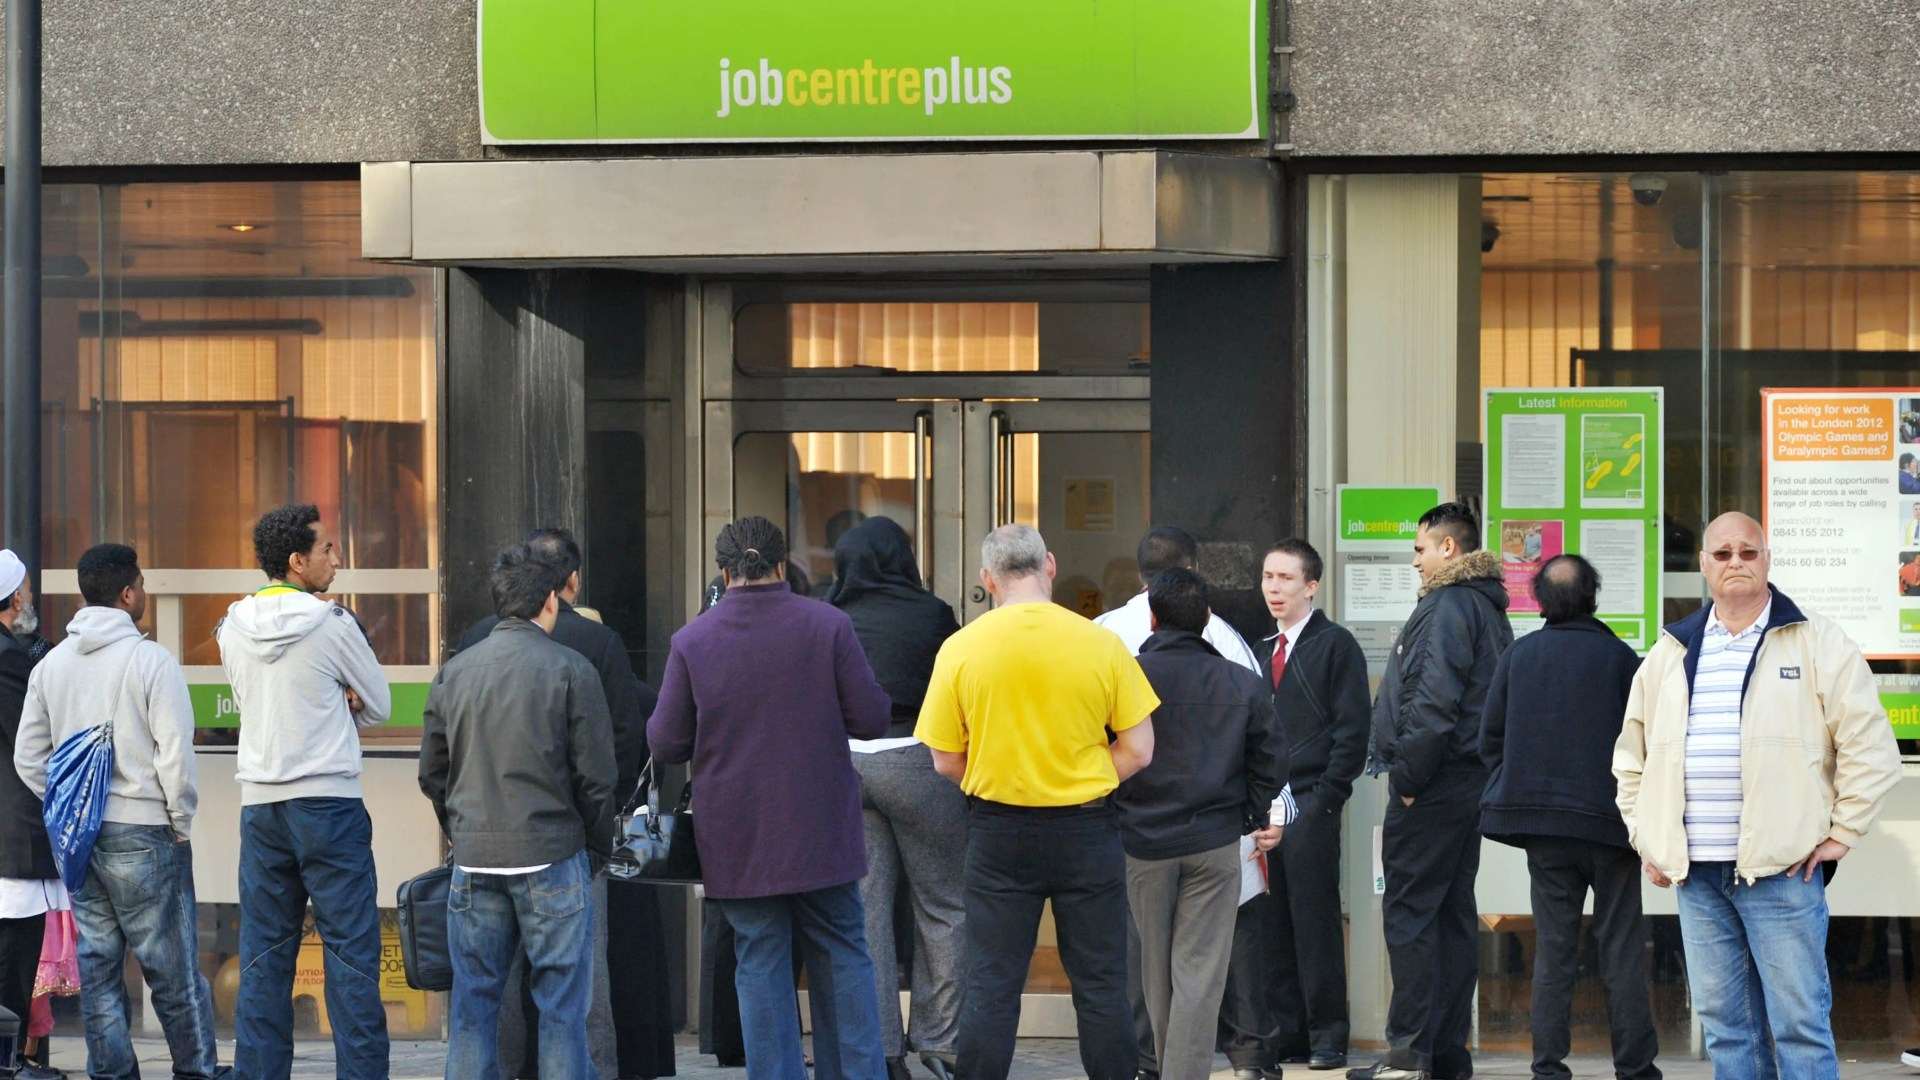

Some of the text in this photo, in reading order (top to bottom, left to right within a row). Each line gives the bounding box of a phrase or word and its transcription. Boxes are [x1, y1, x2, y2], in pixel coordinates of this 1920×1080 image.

[716, 56, 1012, 117] jobcentreplus
[1518, 397, 1628, 408] Latest Information
[1778, 404, 1871, 416] Looking for work
[1778, 418, 1883, 428] in the London 2012
[1778, 432, 1889, 443] Olympic Games and
[1778, 445, 1888, 456] Paralympic Games?
[1773, 477, 1889, 487] Find out about opportunities
[1773, 488, 1808, 496] available
[1848, 488, 1868, 496] wide
[1798, 499, 1807, 507] of
[1808, 499, 1822, 508] job
[1824, 499, 1844, 507] roles
[1846, 499, 1857, 508] by
[1859, 499, 1887, 508] calling
[1773, 528, 1844, 537] 0845 155 2012
[1347, 554, 1372, 562] Opening
[1773, 558, 1847, 567] 0845 60 60 234
[1781, 669, 1799, 677] YSL
